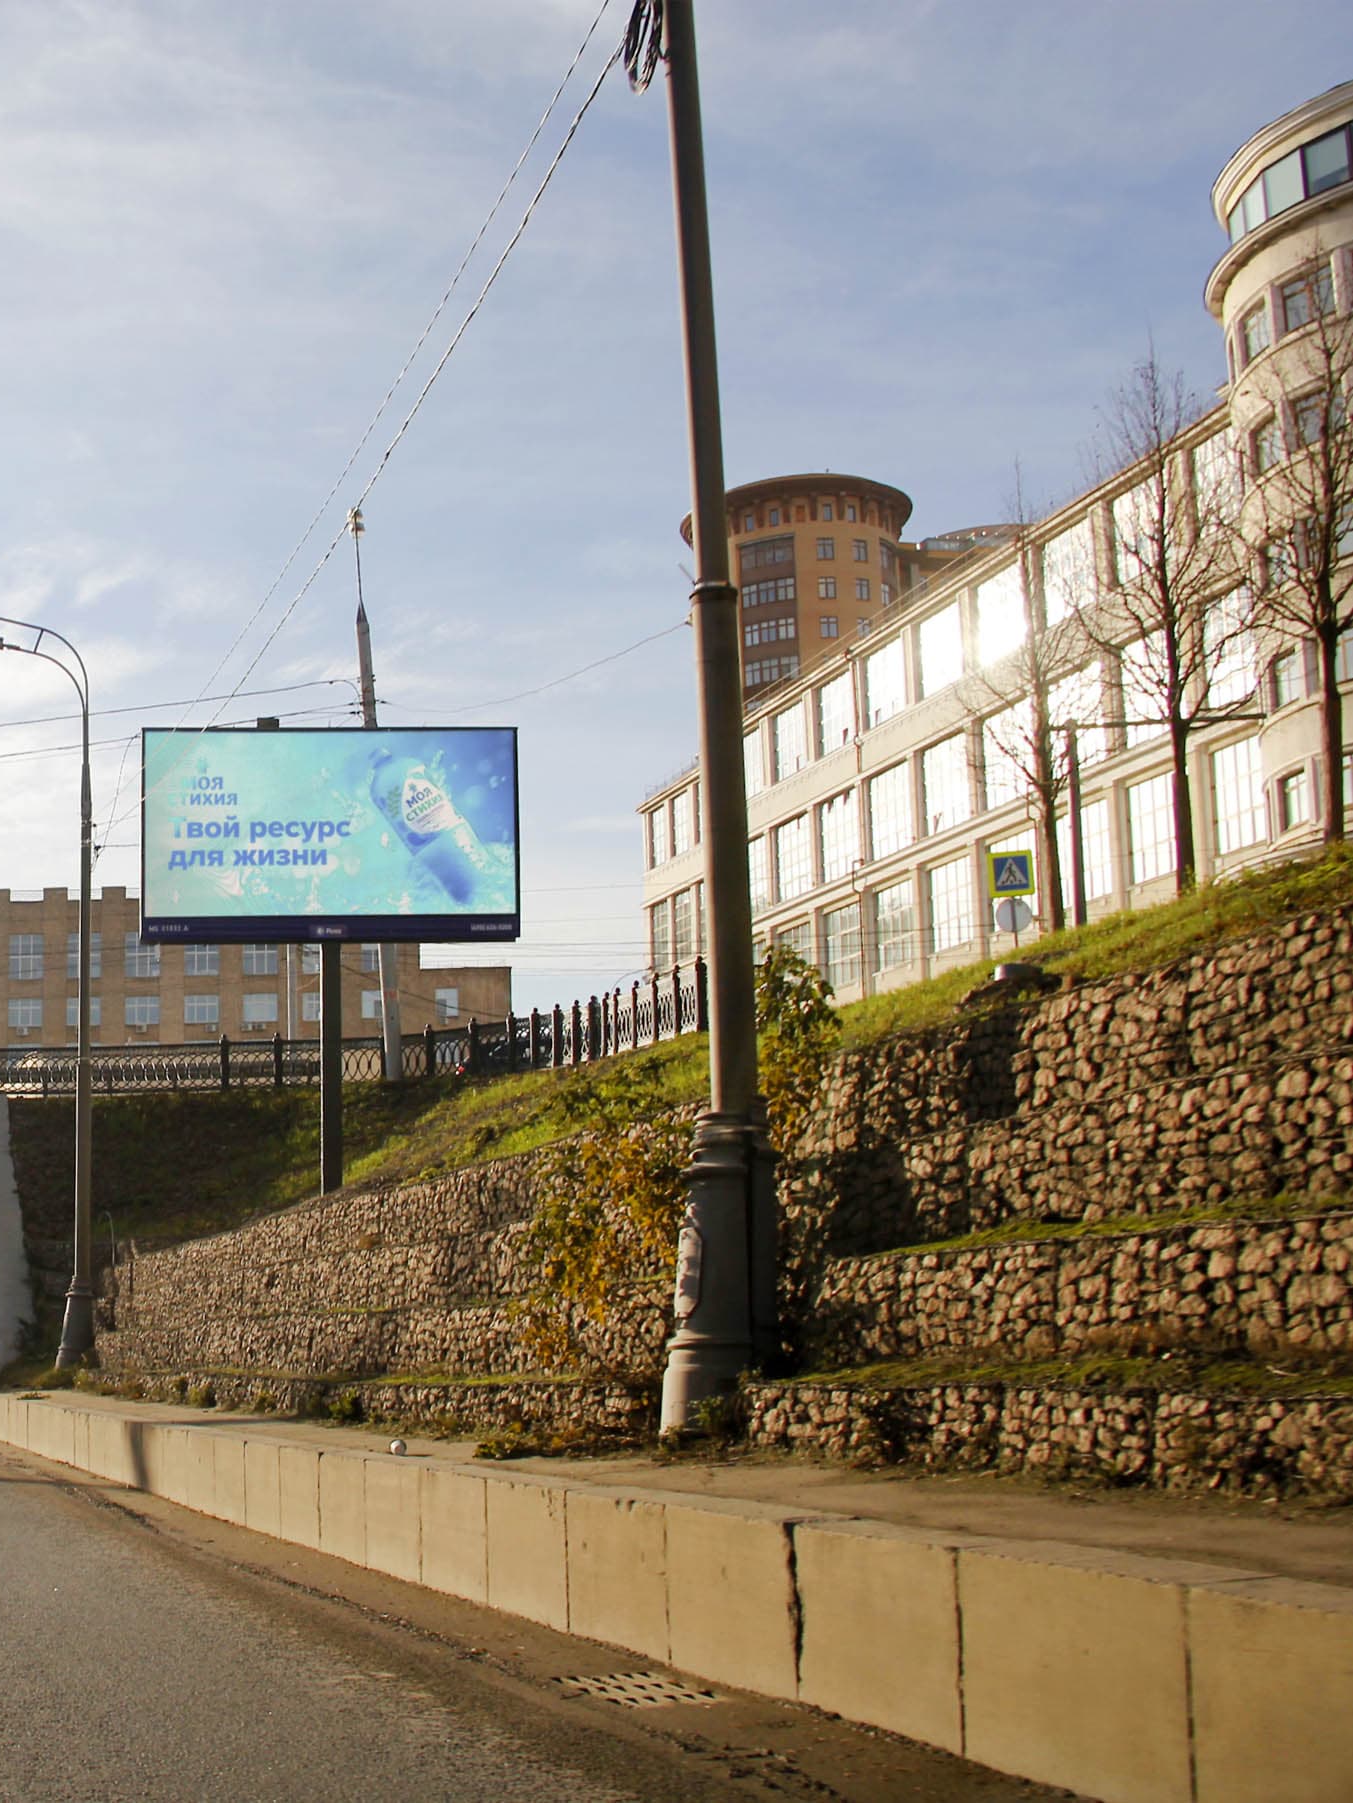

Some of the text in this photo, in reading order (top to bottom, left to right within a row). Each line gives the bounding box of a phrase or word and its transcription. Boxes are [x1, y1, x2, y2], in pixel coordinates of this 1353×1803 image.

[405, 786, 434, 808] МОЯ
[168, 815, 352, 844] Твой ресурс
[168, 849, 328, 871] для жизни
